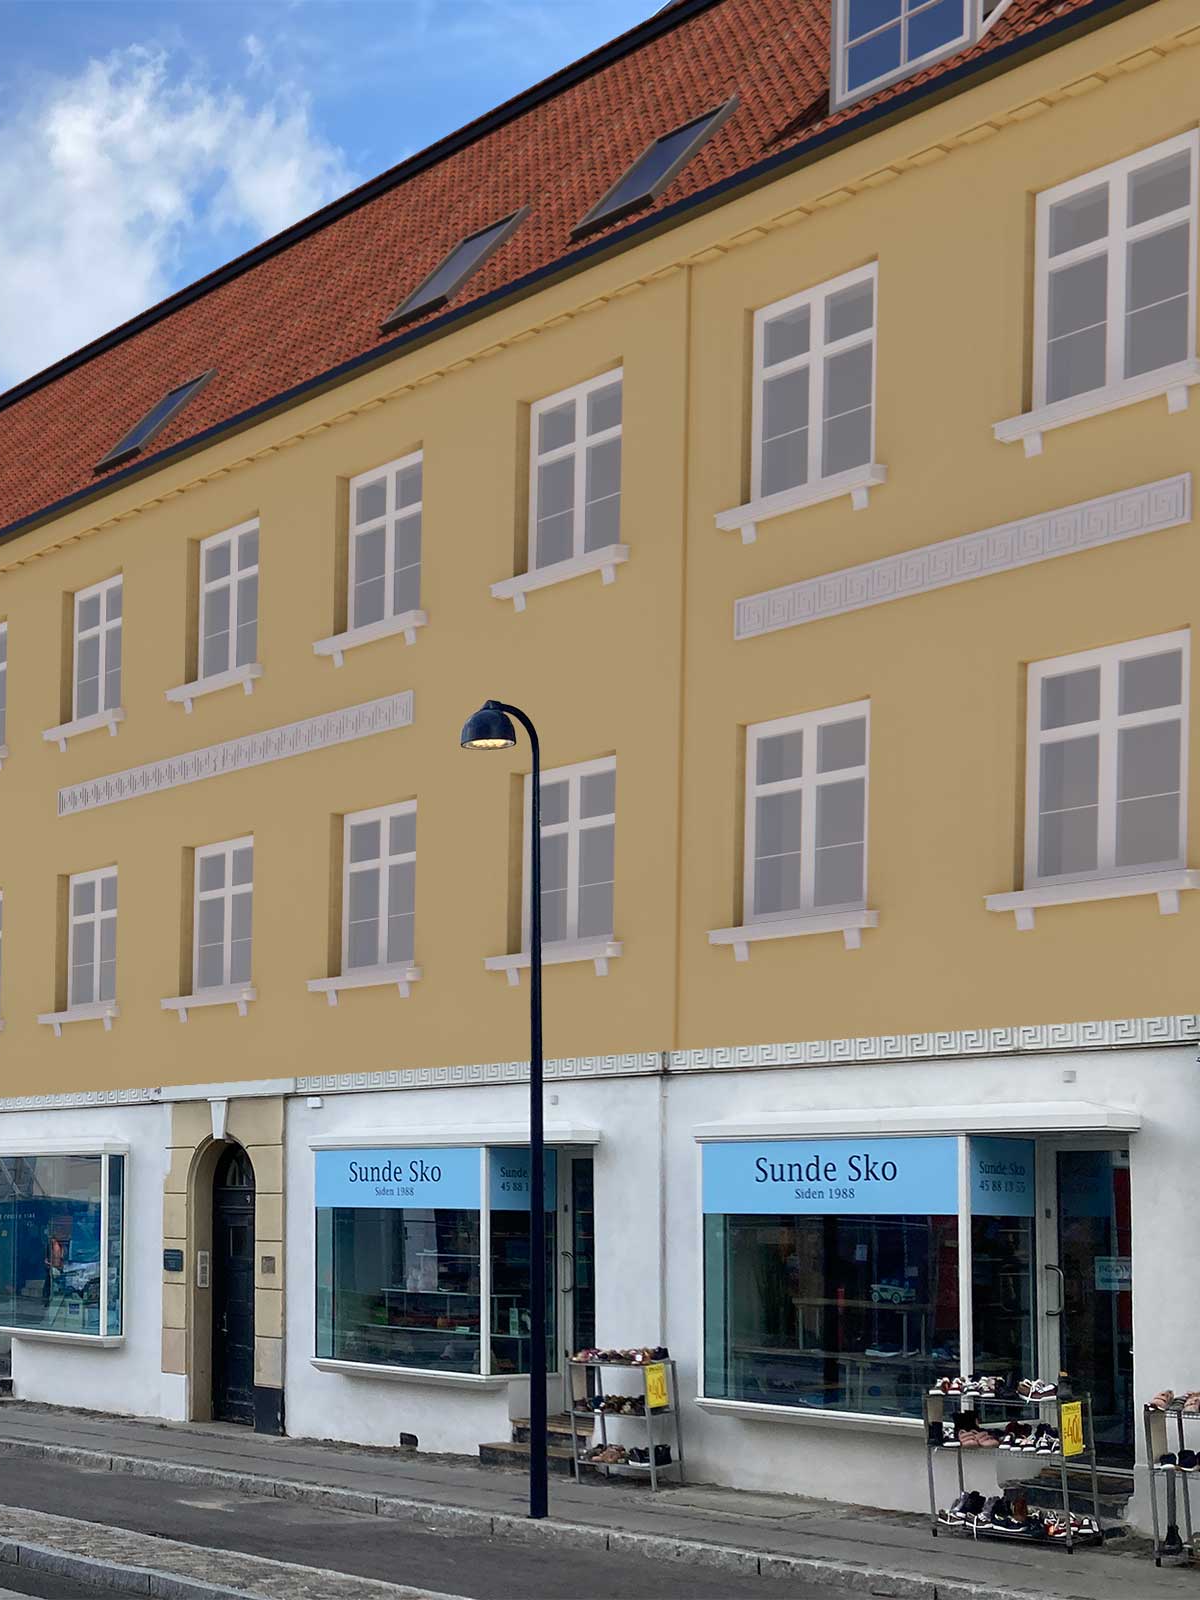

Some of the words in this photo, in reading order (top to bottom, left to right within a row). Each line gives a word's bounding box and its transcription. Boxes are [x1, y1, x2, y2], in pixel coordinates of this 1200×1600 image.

[349, 1160, 402, 1182] Sunde
[409, 1160, 442, 1182] Sko
[755, 1154, 837, 1183] Sunde
[848, 1153, 898, 1182] Sko
[979, 1160, 1007, 1175] Sunde
[375, 1186, 395, 1197] Siden
[500, 1181, 511, 1192] 45
[979, 1180, 990, 1191] 45
[795, 1188, 825, 1199] Siden
[829, 1187, 855, 1199] 1988
